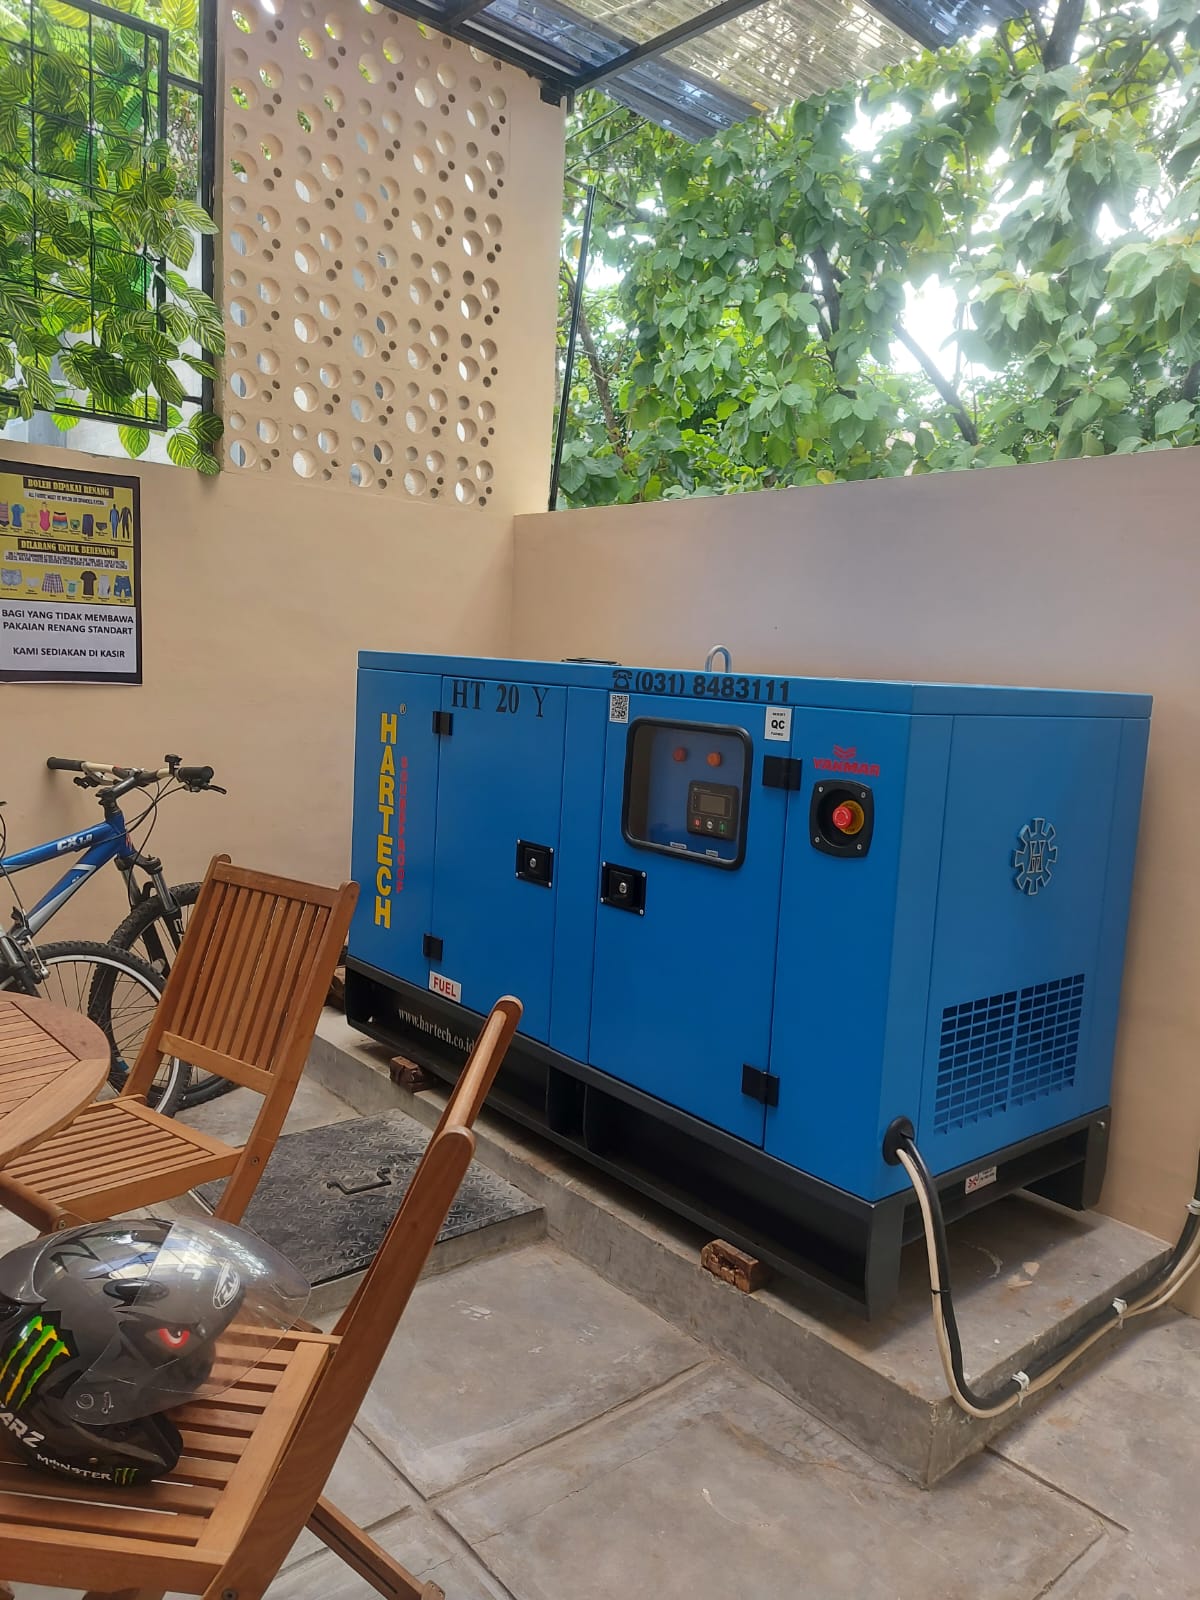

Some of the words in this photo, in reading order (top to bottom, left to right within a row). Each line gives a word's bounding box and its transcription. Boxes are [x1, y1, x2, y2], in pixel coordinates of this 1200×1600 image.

[58, 543, 80, 555] UNTUK
[1, 609, 25, 618] BAGI
[27, 610, 54, 620] YANG
[55, 612, 83, 621] TIDAK
[84, 613, 134, 624] MEMBAWA
[3, 621, 45, 631] PAKAIAN
[47, 623, 86, 633] RENANG
[87, 625, 133, 635] STANDART
[12, 647, 39, 656] KAMI
[40, 647, 87, 657] SEDIAKAN
[88, 649, 98, 657] DI
[100, 649, 126, 658] KASIR
[635, 671, 686, 695] (031)
[692, 675, 790, 704] 8483111
[451, 680, 486, 710] HT
[495, 683, 520, 714] 20
[531, 686, 551, 718] Y
[770, 719, 786, 730] QC
[813, 757, 881, 777] YANMAR
[374, 711, 398, 929] HARTECH
[433, 976, 457, 998] FUEL
[398, 1008, 475, 1054] www.hartech.co.id
